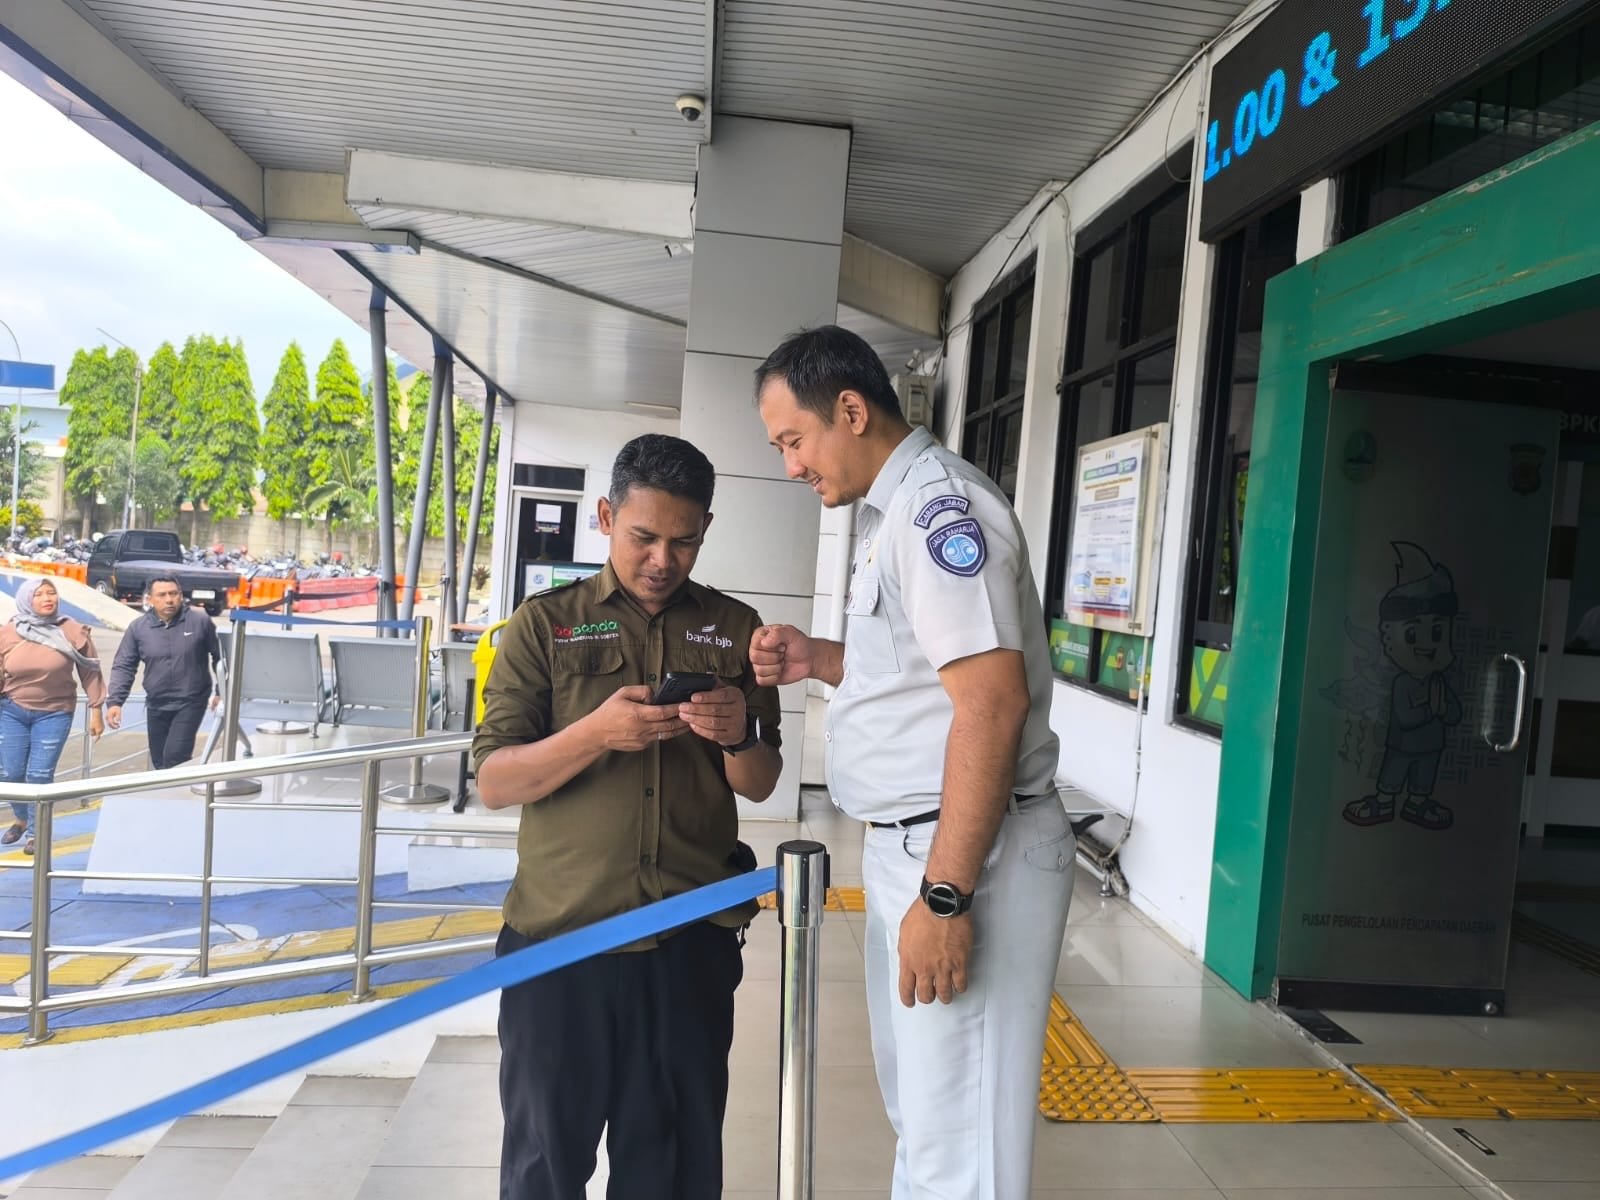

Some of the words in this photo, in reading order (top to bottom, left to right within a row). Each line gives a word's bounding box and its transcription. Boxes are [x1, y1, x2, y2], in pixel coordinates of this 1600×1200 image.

[1299, 32, 1340, 108] &
[932, 534, 946, 547] JASA
[946, 525, 974, 537] RAHARJA
[687, 630, 713, 645] bank
[715, 636, 733, 648] bjb
[1301, 913, 1332, 928] PUSAT
[1332, 914, 1399, 929] PENGELOLAAN
